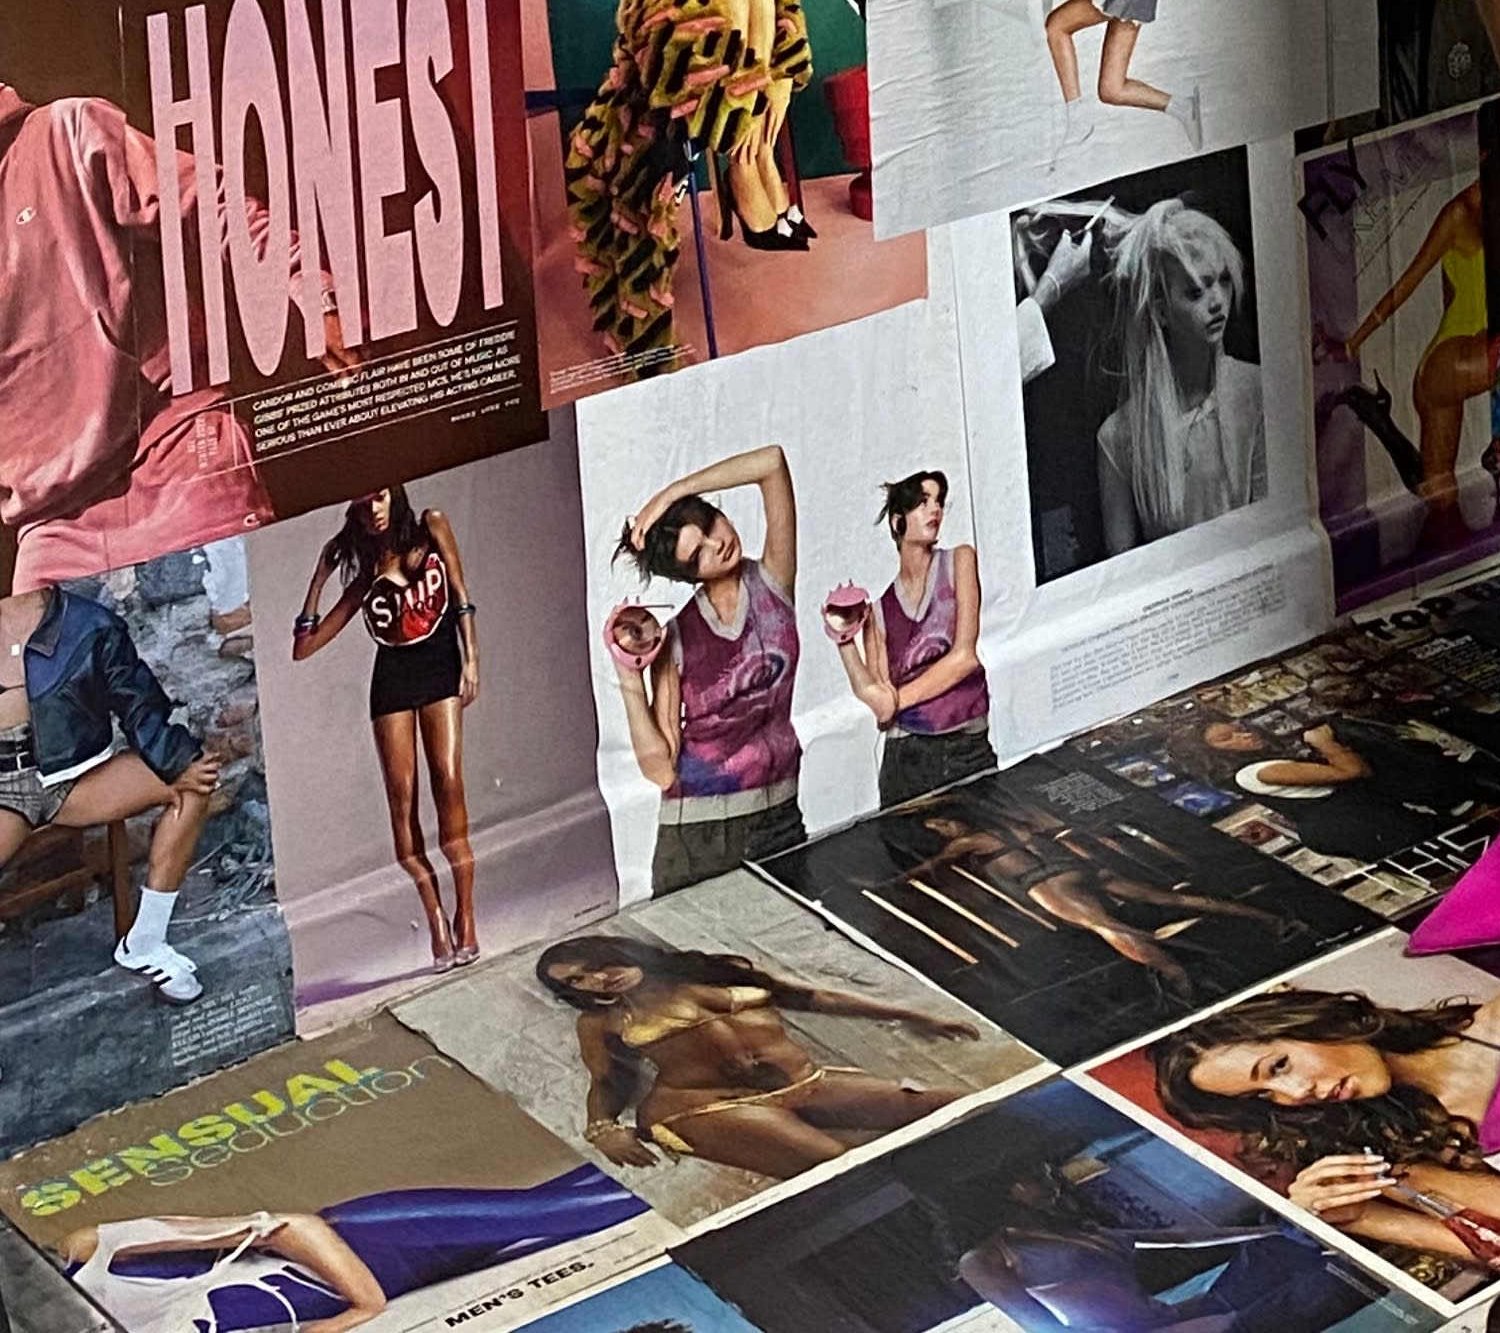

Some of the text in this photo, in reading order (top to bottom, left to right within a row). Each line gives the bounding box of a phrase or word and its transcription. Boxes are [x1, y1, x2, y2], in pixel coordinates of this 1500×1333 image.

[252, 393, 294, 412] CANDOR
[295, 386, 315, 400] AND
[360, 366, 386, 382] FLAIR
[387, 359, 411, 374] HAVE
[412, 352, 437, 367] BEEN
[438, 344, 463, 359] SOME
[464, 339, 478, 352] OF
[255, 423, 277, 438] ONE
[277, 419, 291, 432] OF
[292, 413, 311, 428] THE
[312, 404, 347, 422] GAME'S
[347, 396, 375, 412] MOST
[375, 381, 426, 403] RESPECTED
[471, 362, 494, 376] NOW
[495, 354, 521, 369] MORE
[286, 399, 318, 416] PRIZED
[372, 376, 398, 391] BOTH
[399, 373, 409, 385] IN
[410, 367, 430, 380] AND
[430, 361, 449, 374] OUT
[450, 356, 463, 369] OF
[495, 344, 509, 356] AS
[255, 433, 297, 453] SERIOUS
[297, 425, 323, 440] THAN
[323, 417, 348, 433] EVER
[348, 408, 380, 426] ABOUT
[380, 395, 429, 416] ELEVATING
[429, 390, 446, 402] HIS
[446, 379, 480, 397] ACTING
[1352, 595, 1454, 642] TOP
[20, 1058, 384, 1218] SENSUAL
[143, 1053, 455, 1188] seduction
[444, 1259, 596, 1328] MEN'S TEES.
